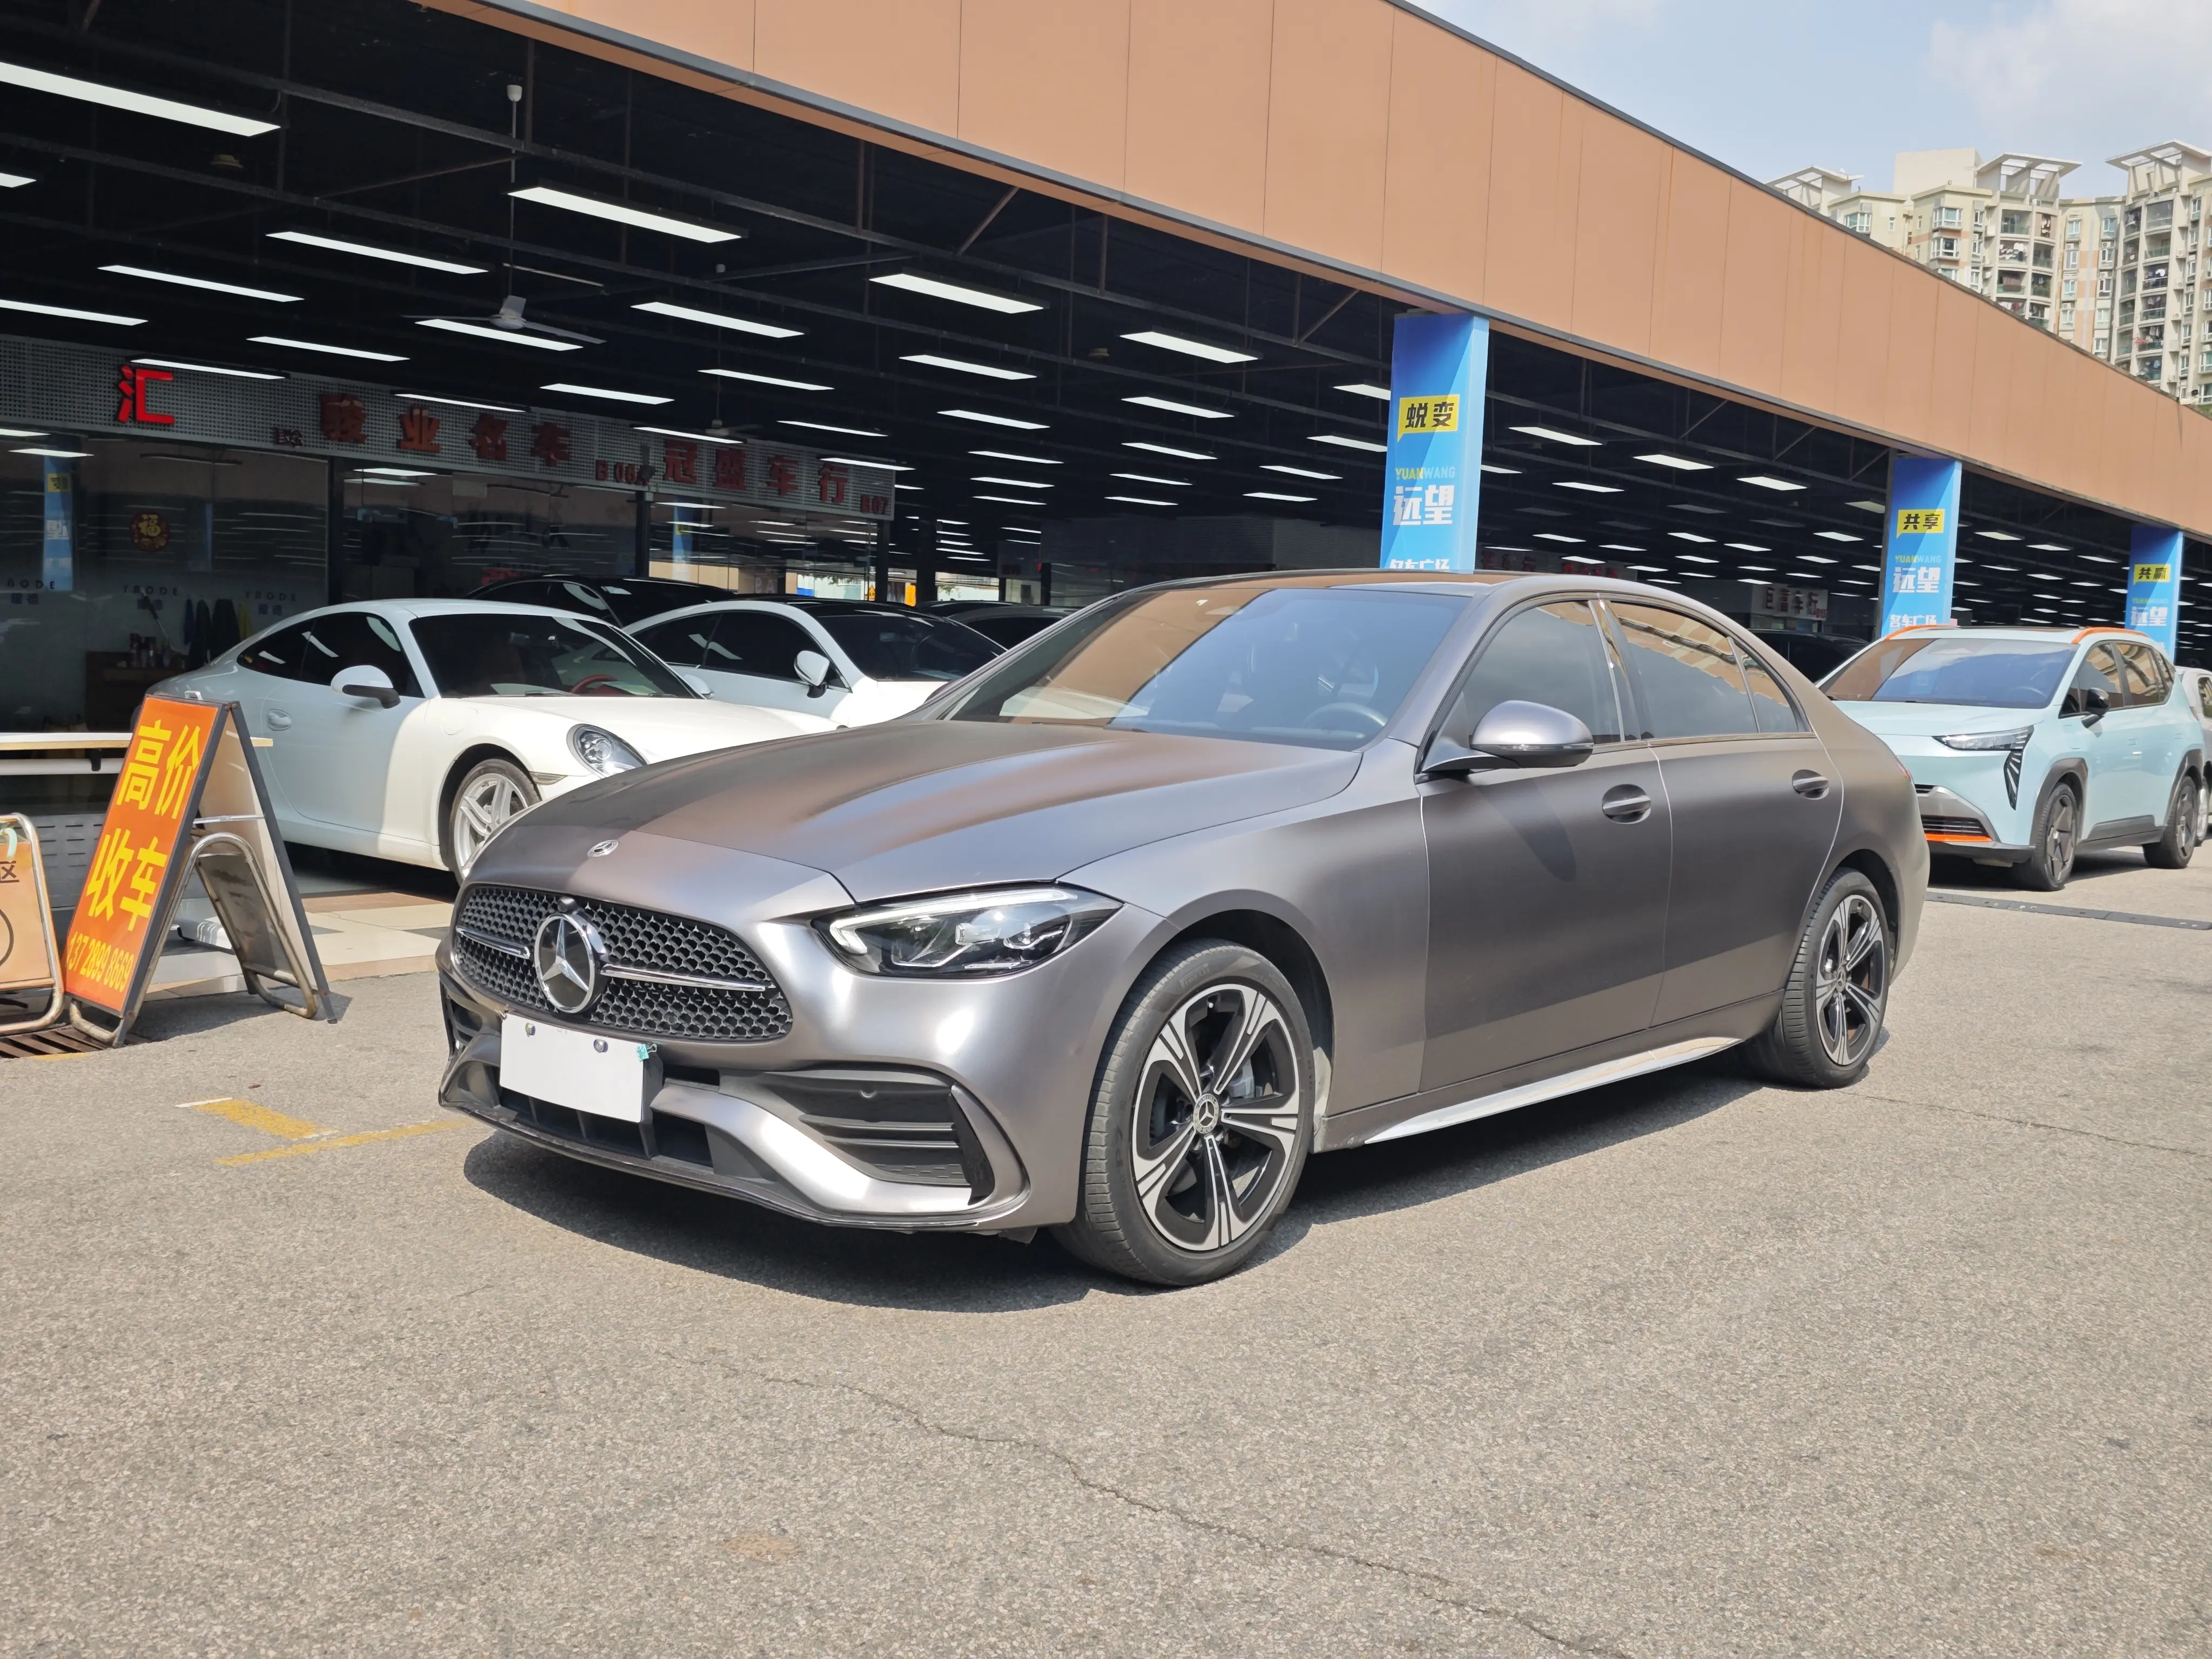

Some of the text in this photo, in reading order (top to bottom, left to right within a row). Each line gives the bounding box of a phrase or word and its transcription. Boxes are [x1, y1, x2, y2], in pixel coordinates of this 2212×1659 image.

[117, 365, 174, 425] 汇
[1405, 402, 1453, 428] 蜕变
[664, 439, 848, 504] 冠盛车行
[1395, 466, 1455, 480] YUANWANG
[1393, 484, 1454, 525] 远望
[1903, 514, 1940, 530] 共享
[1895, 555, 1941, 563] YUANWANG
[1892, 567, 1940, 593] 远望
[2130, 606, 2167, 626] 远望
[117, 719, 201, 819] 高价
[86, 828, 168, 932] 收车
